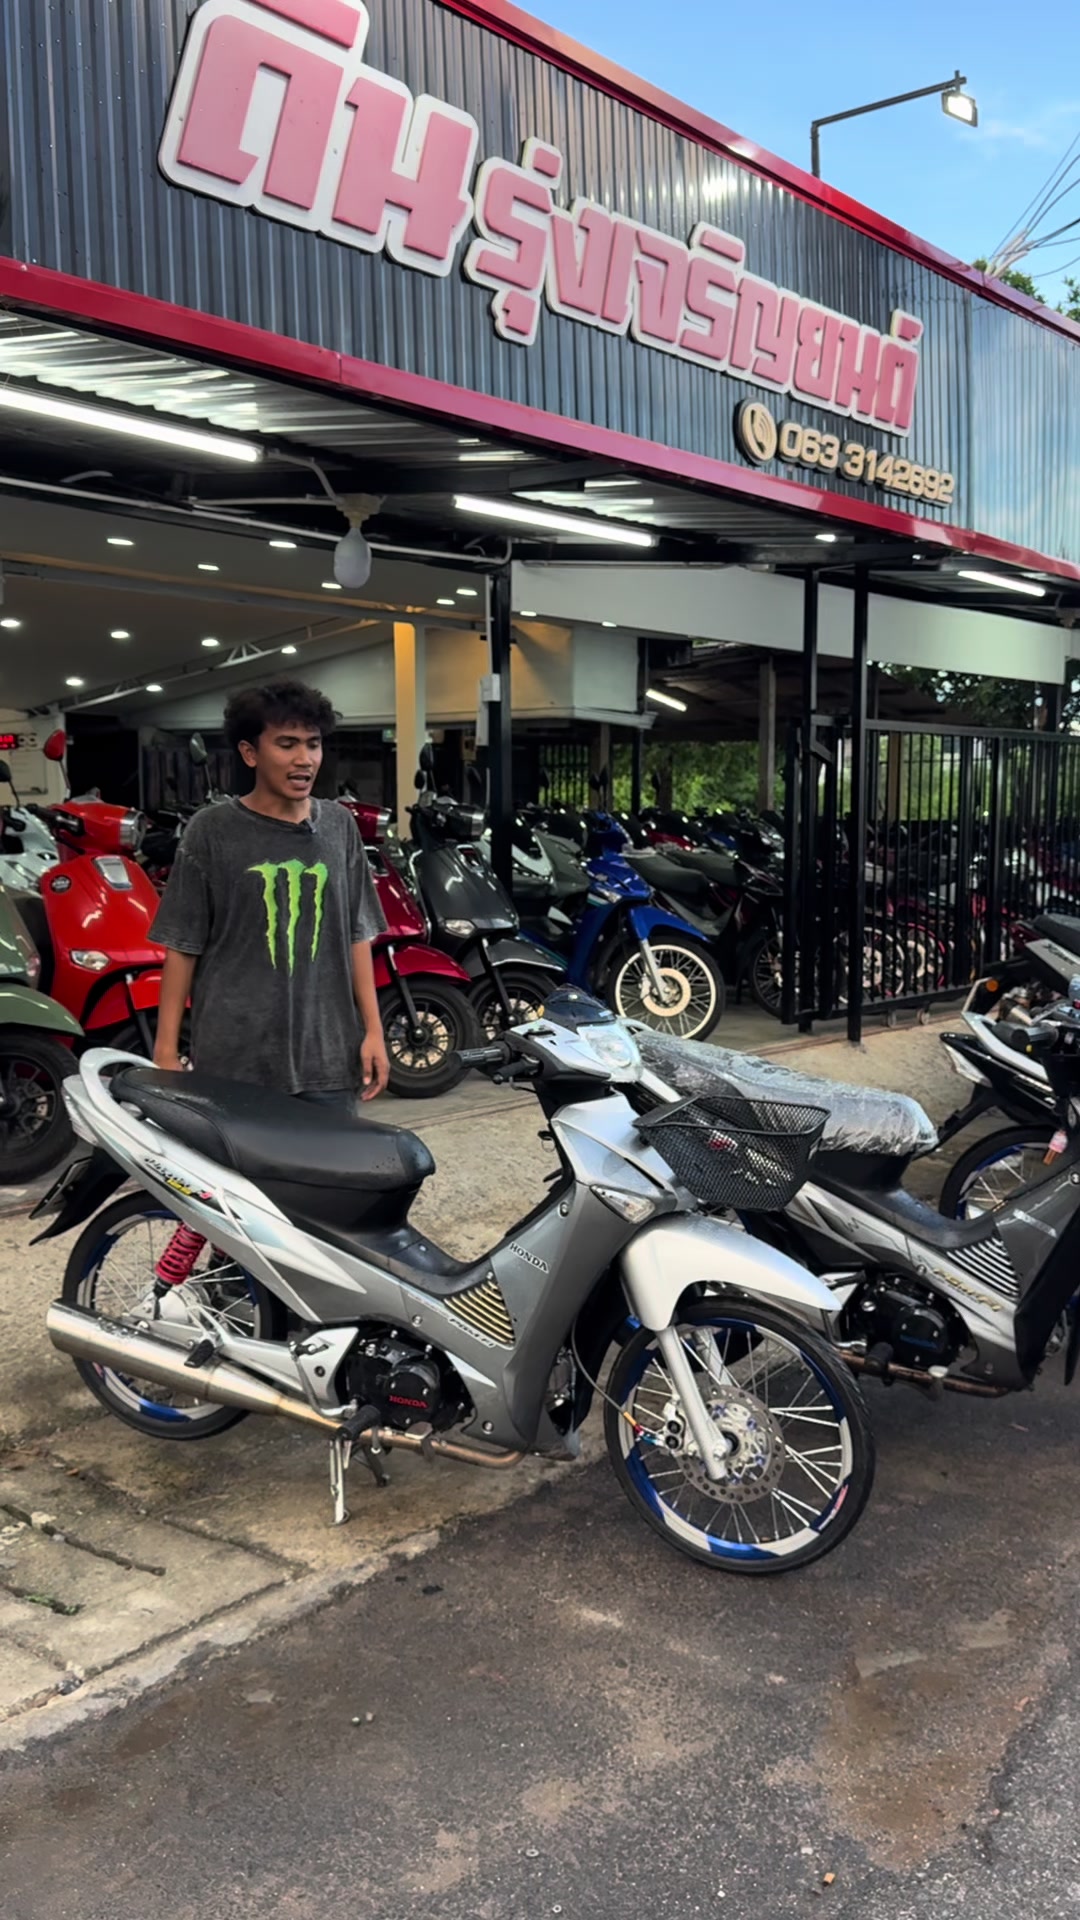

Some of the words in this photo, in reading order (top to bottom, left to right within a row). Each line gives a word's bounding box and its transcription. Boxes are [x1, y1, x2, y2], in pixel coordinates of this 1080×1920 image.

[780, 421, 840, 470] 063
[842, 444, 955, 504] 3142692
[510, 1242, 549, 1274] HONDA
[389, 1395, 428, 1408] HONDA
